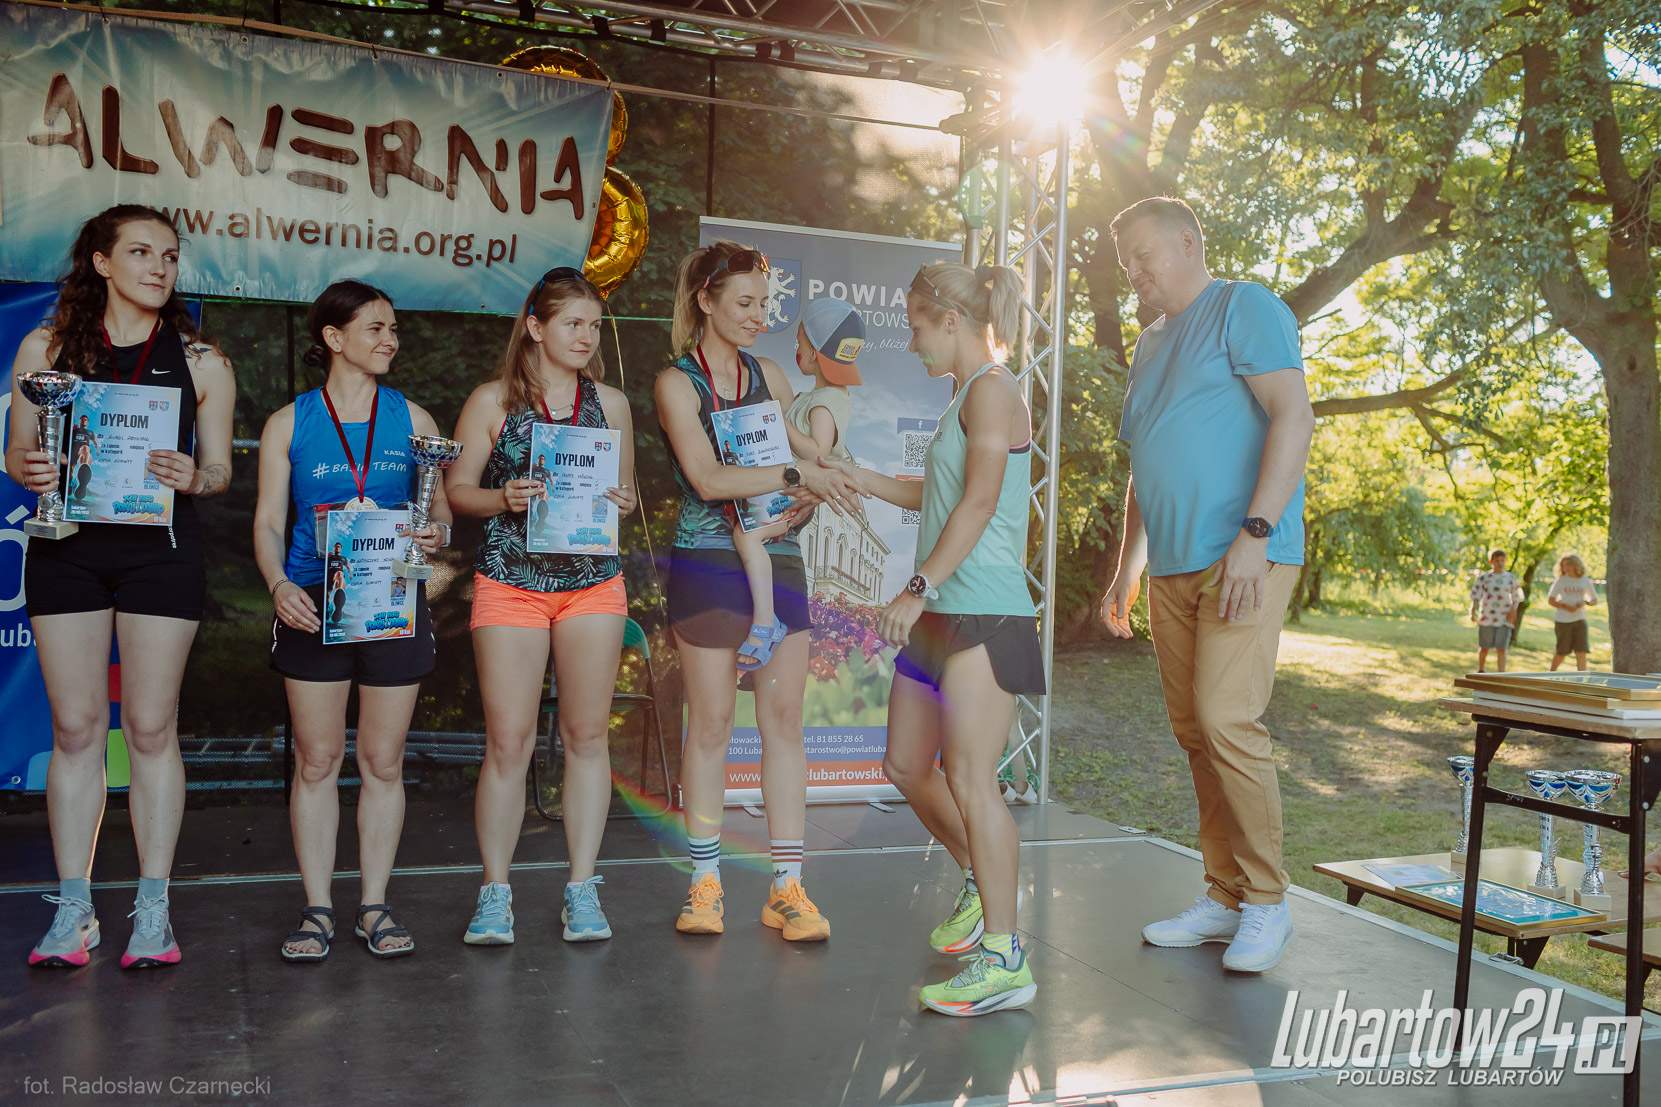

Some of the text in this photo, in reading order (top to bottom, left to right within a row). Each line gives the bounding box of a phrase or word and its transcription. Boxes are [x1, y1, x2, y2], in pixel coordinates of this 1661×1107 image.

[27, 72, 585, 221] ALWERNIA
[808, 279, 908, 309] POWIA
[858, 311, 910, 329] TOWS
[100, 412, 149, 429] DYPLOM
[735, 428, 769, 447] DYPLOM
[372, 461, 406, 473] TEAM
[554, 452, 595, 468] DYPLOM
[352, 537, 395, 552] DYPLOM
[728, 746, 743, 755] 100
[804, 745, 887, 754] tarostwo@powiatluba
[729, 773, 761, 783] www
